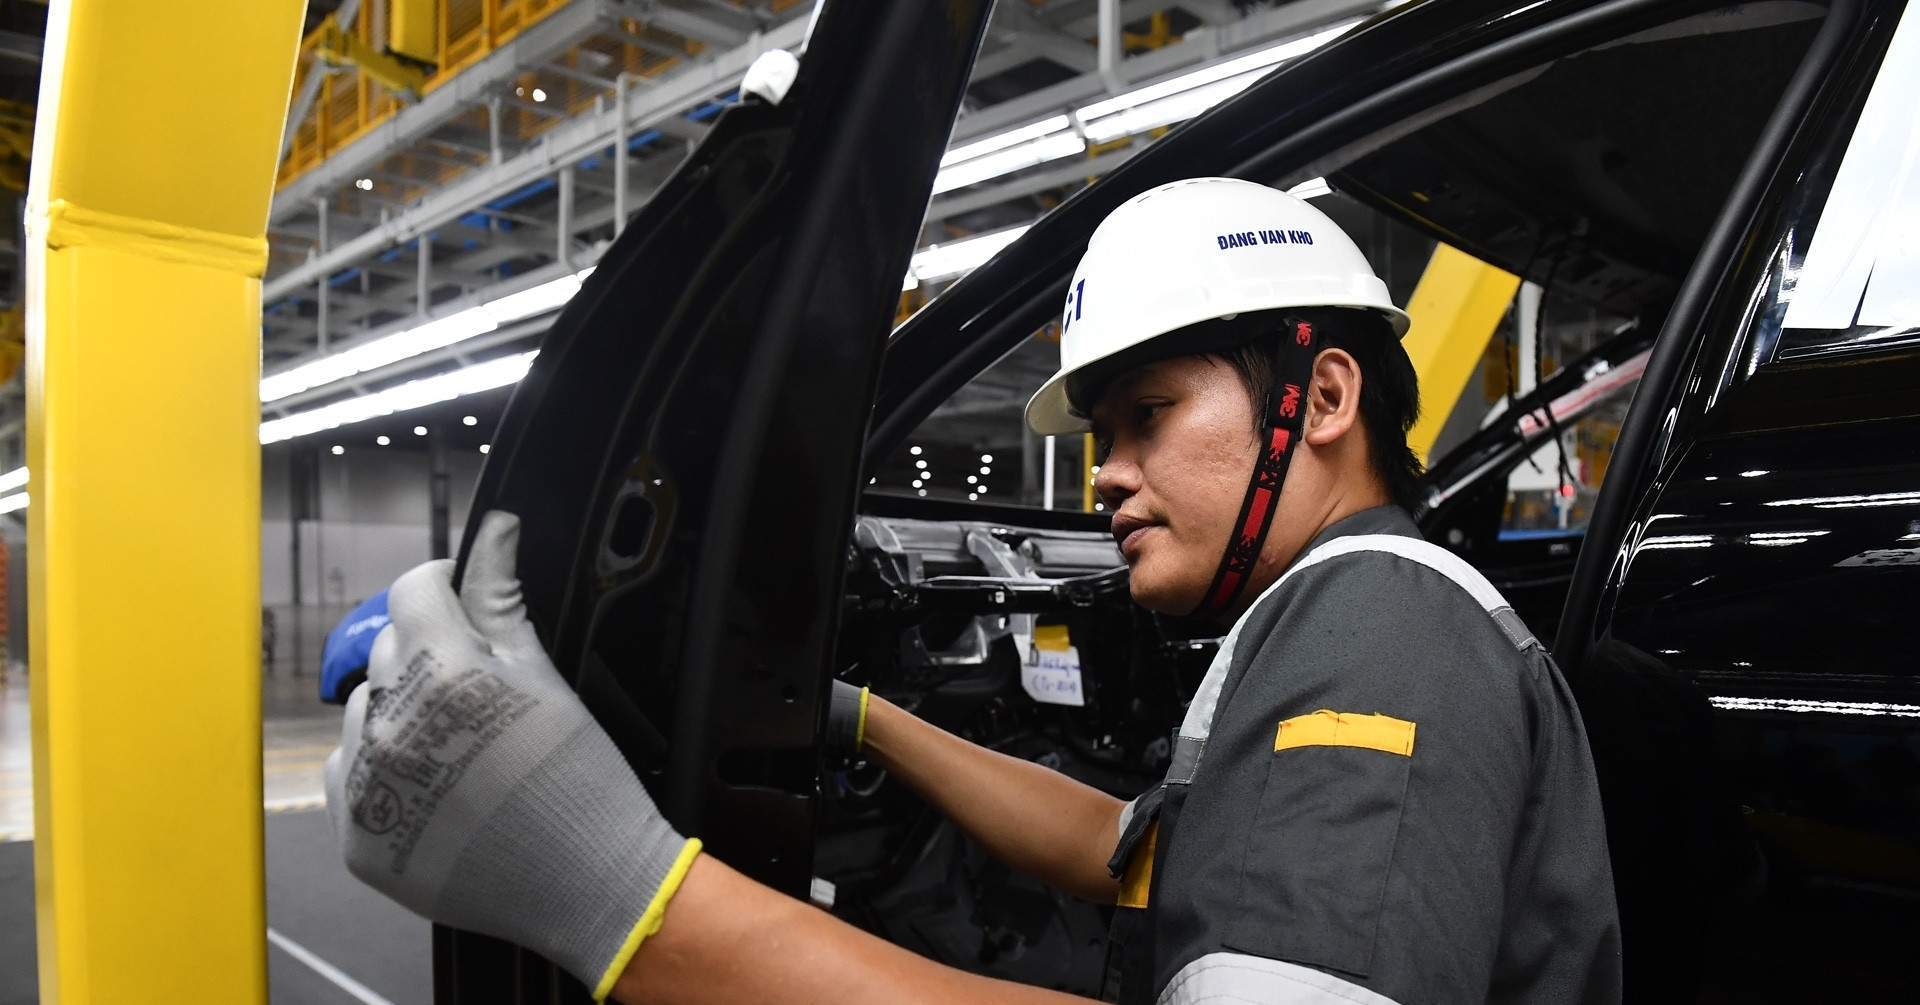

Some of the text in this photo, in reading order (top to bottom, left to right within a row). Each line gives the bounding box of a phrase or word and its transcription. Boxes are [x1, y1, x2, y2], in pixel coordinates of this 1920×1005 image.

[1258, 230, 1287, 245] VAN
[1288, 230, 1313, 245] KHO
[1280, 383, 1301, 418] 3M
